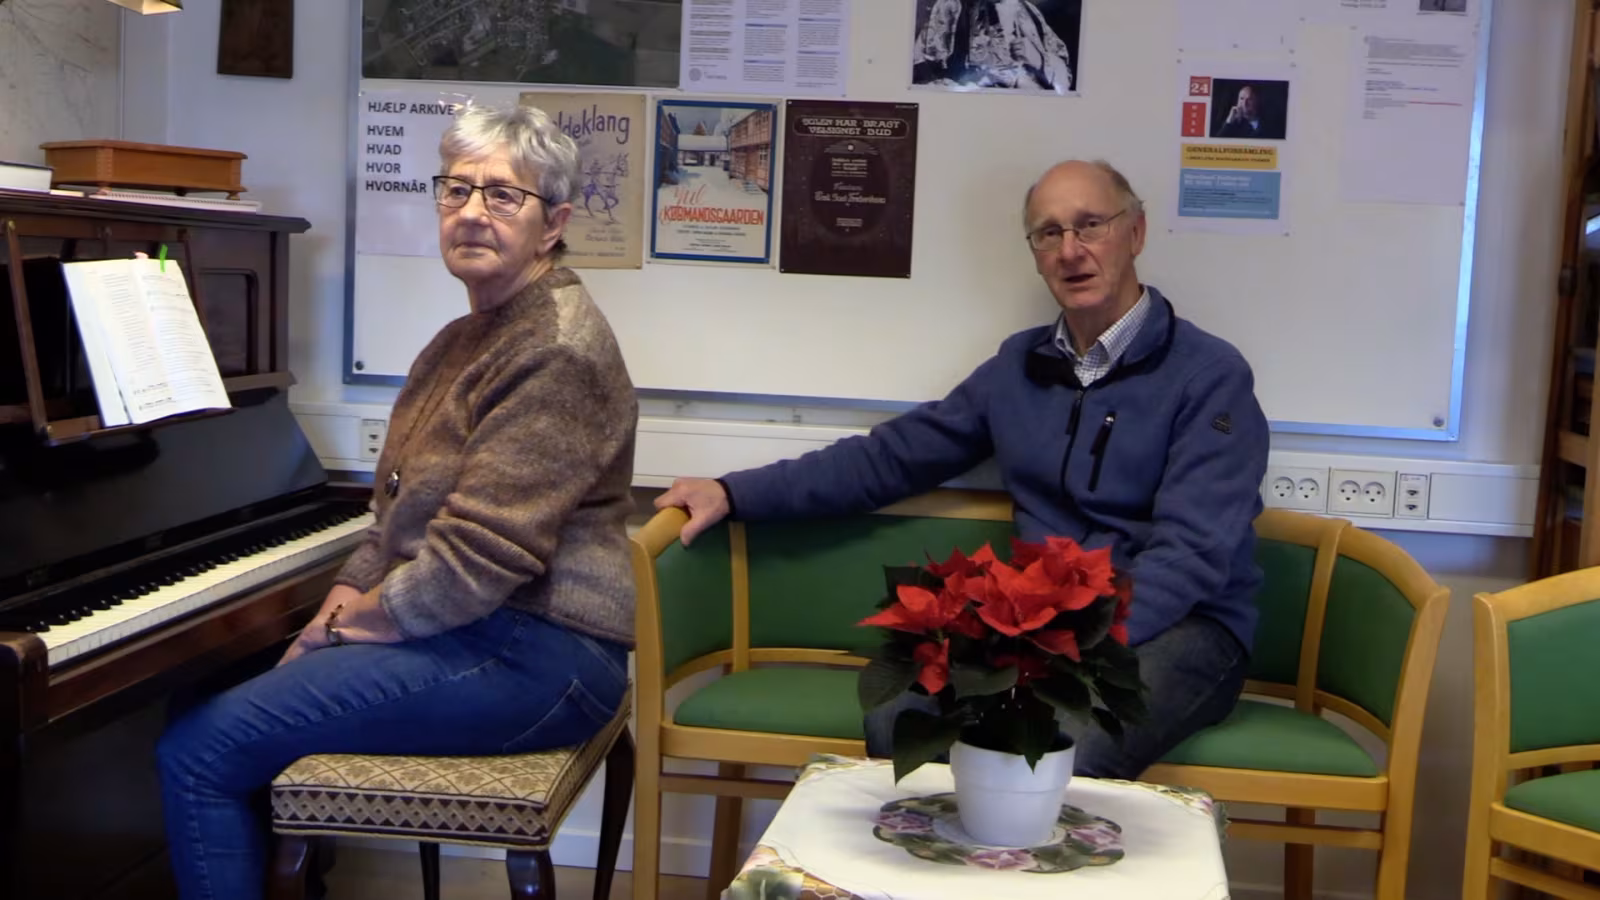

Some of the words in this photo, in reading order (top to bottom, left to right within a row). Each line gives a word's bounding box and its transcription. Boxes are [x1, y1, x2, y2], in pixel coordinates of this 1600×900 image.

[1191, 83, 1209, 94] 24
[368, 101, 407, 114] HJÆLP
[552, 104, 631, 145] ldeklang
[835, 119, 858, 127] HAR
[863, 120, 900, 129] BRAGT
[367, 125, 404, 137] HVEM
[866, 128, 892, 136] BUD
[366, 144, 402, 155] HVAD
[366, 162, 401, 174] HVOR
[365, 179, 427, 193] HVORNÅR
[664, 206, 765, 225] KØBMANDSGAARDEN
